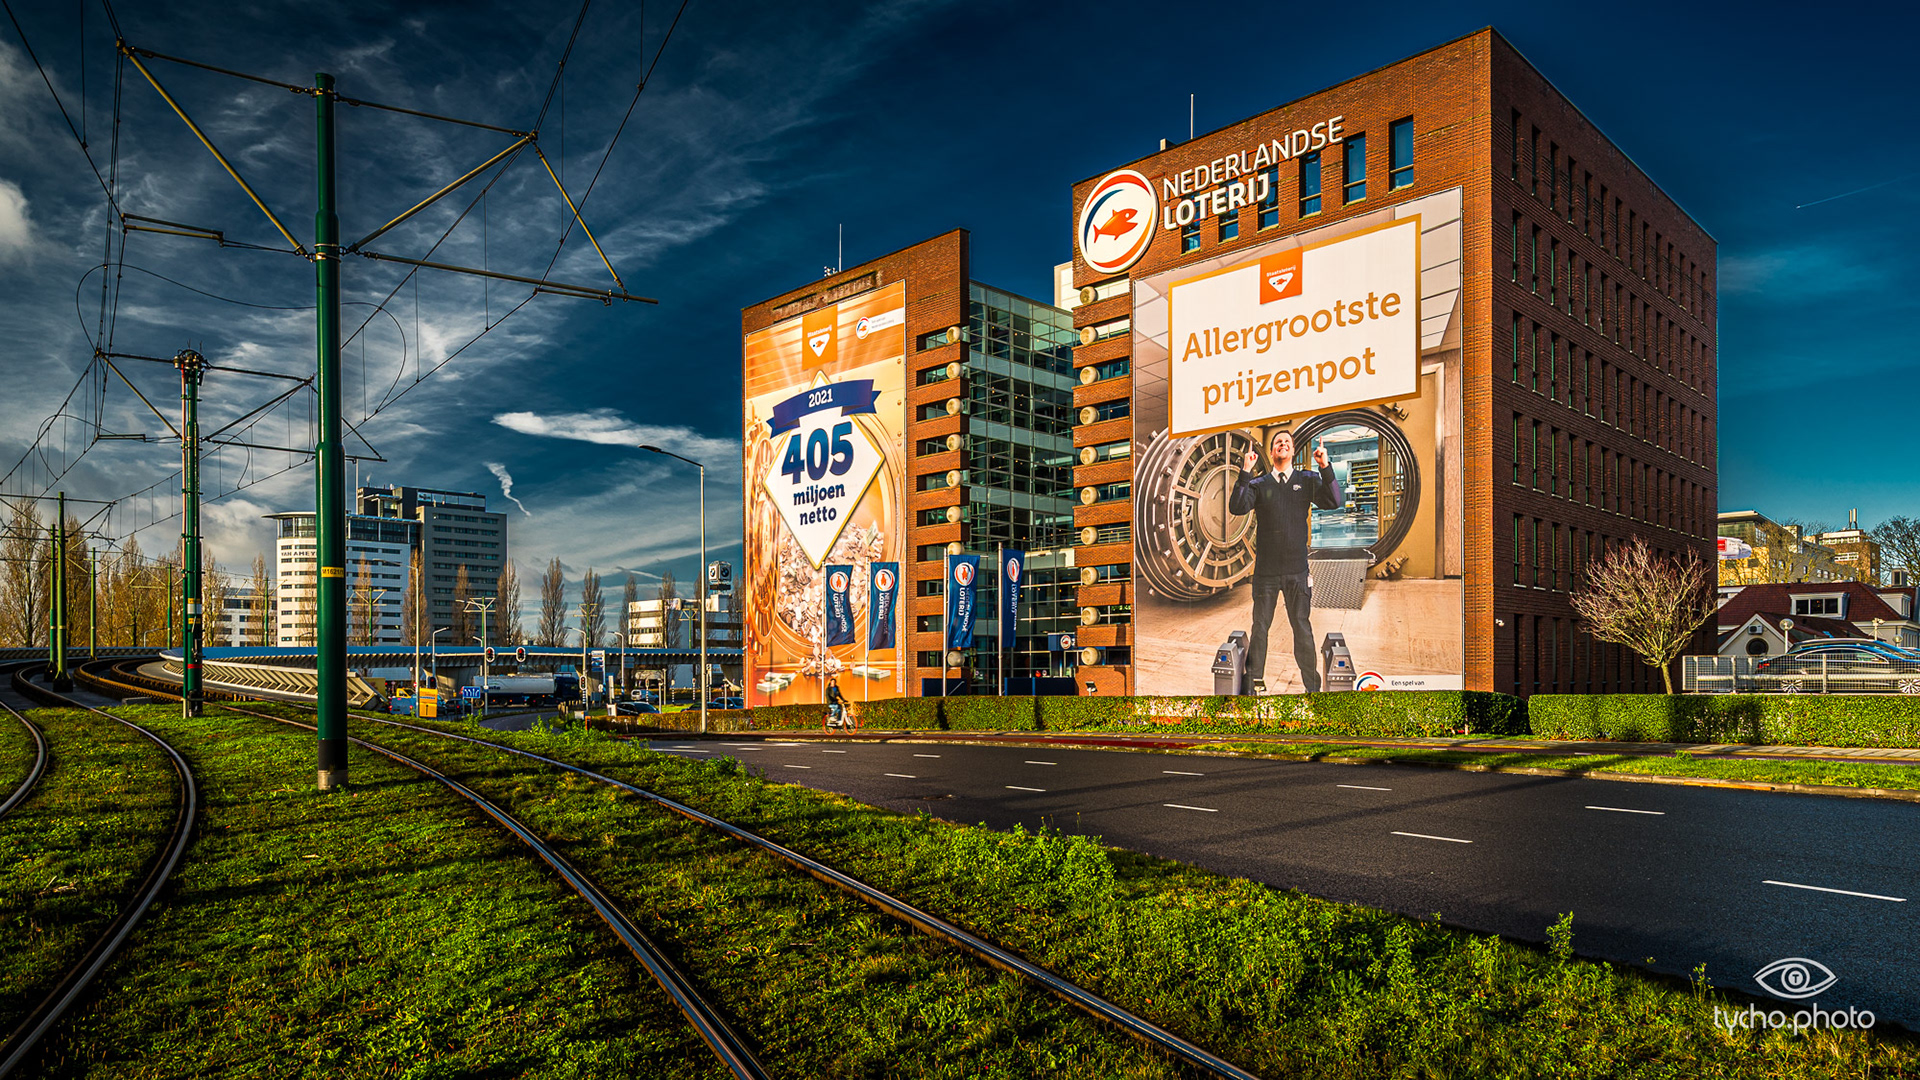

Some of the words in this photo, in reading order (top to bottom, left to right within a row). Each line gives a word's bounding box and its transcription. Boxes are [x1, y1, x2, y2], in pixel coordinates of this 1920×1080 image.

[1163, 115, 1344, 201] NEDERLANDSE
[1163, 173, 1270, 230] LOTERIJ
[1182, 292, 1401, 362] Allergrootste
[808, 388, 833, 408] 2021
[1202, 347, 1376, 414] prijzenpot
[781, 421, 854, 485] 405
[793, 483, 845, 506] miljoen
[799, 506, 837, 526] netto
[958, 587, 966, 616] LOTERIJ
